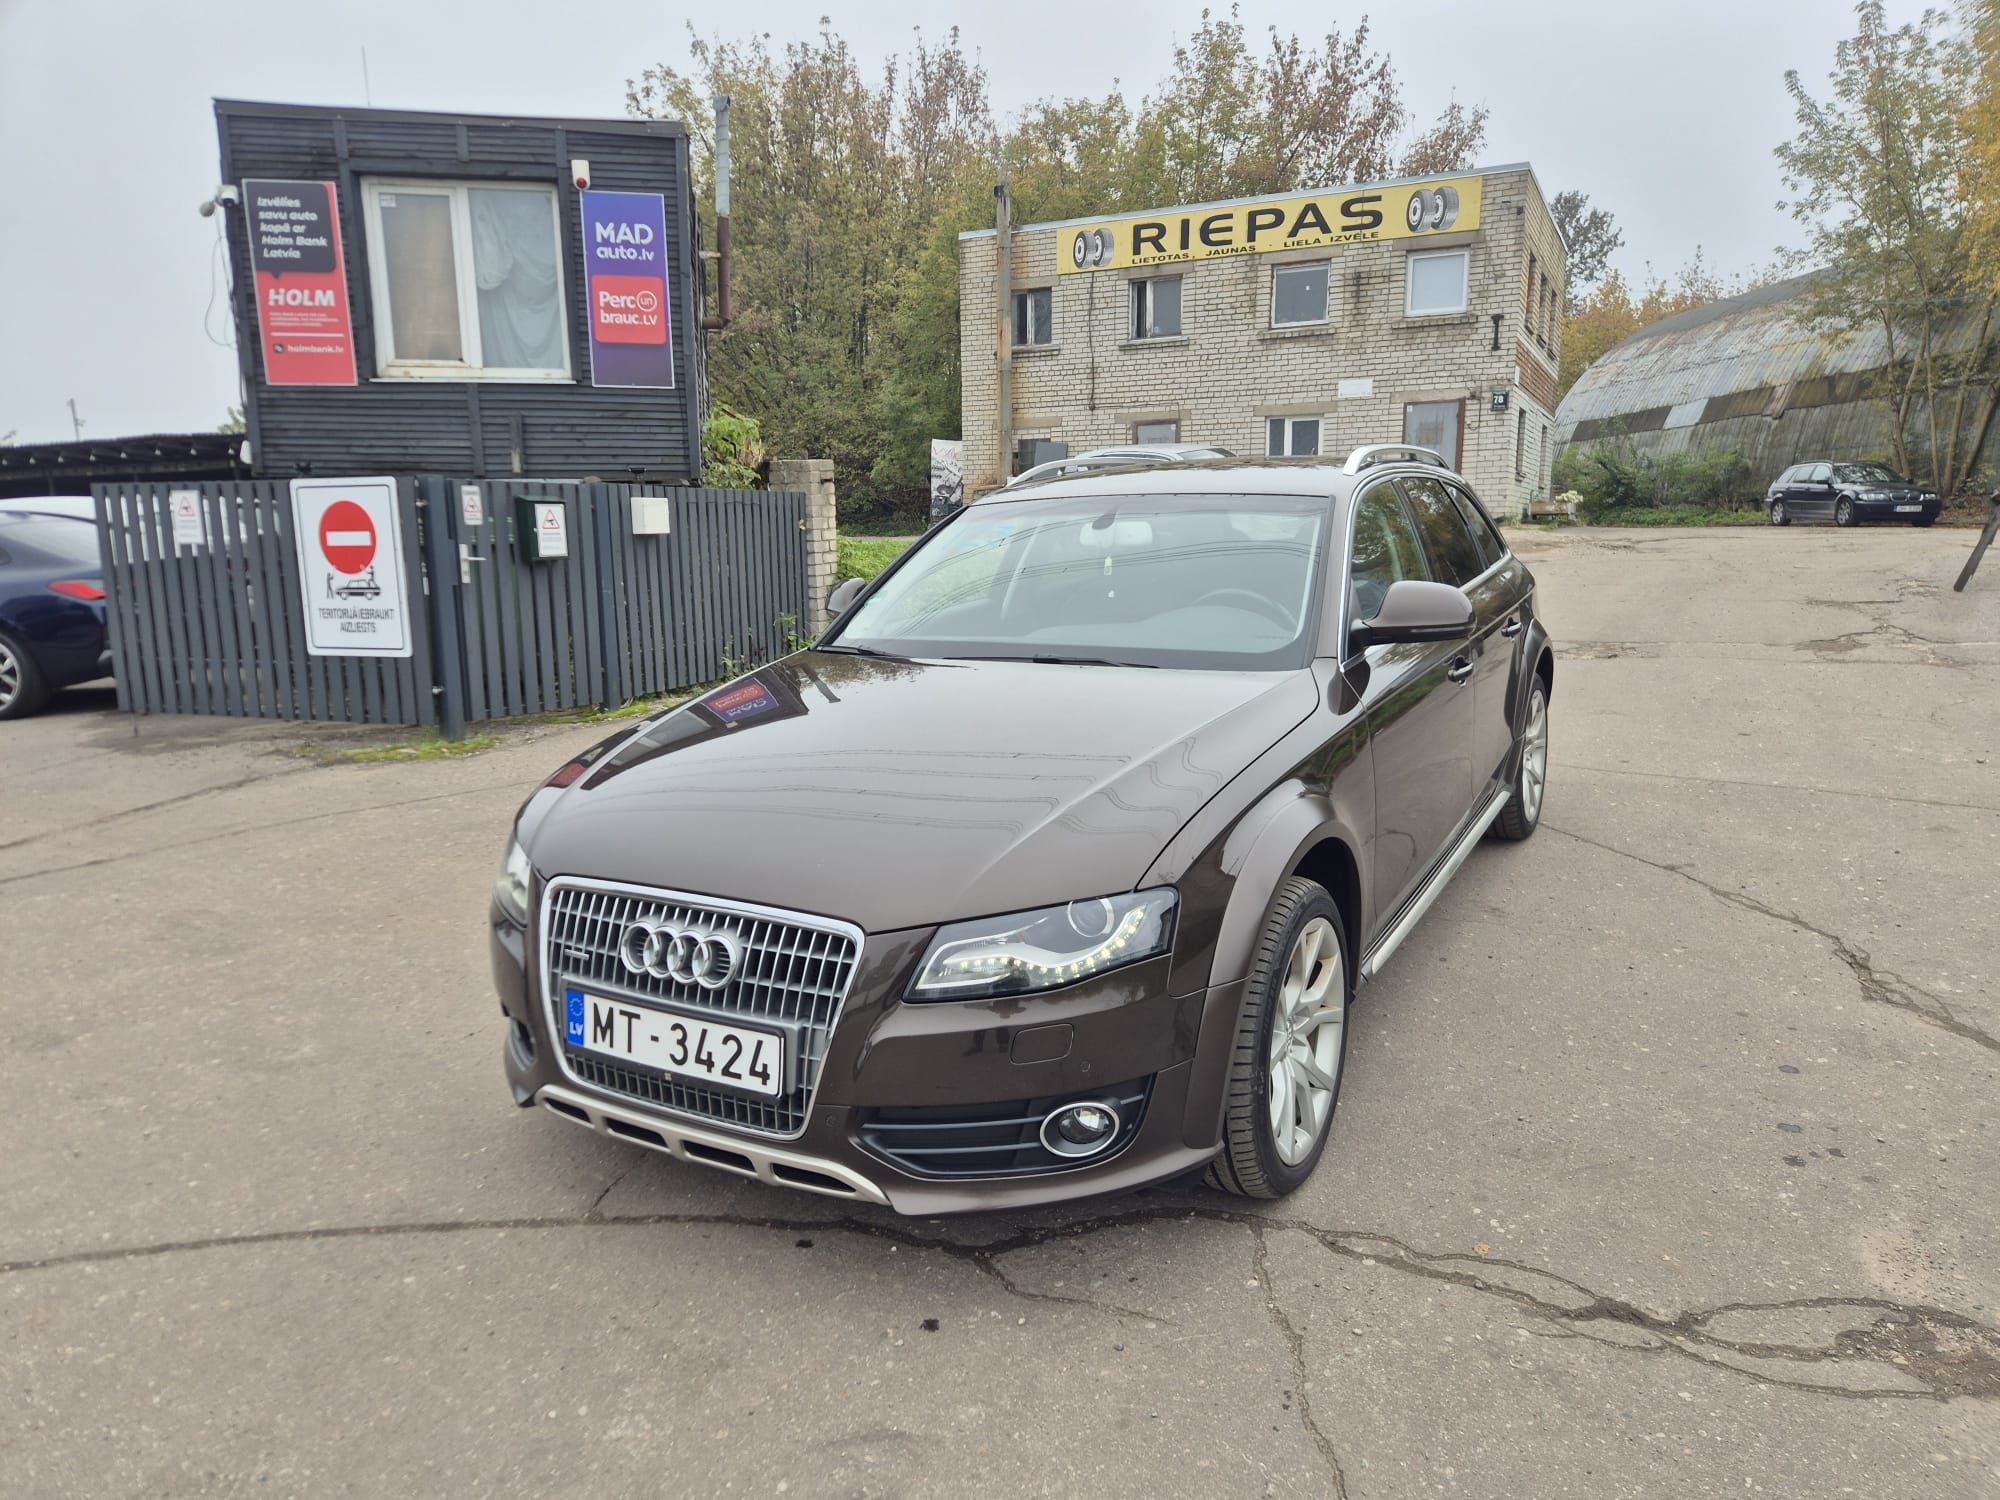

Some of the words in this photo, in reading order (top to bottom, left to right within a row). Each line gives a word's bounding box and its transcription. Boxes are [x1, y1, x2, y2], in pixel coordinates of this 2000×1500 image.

[258, 211, 287, 220] savu
[289, 211, 318, 221] auto
[260, 222, 291, 234] kopā
[292, 224, 306, 233] ar
[595, 221, 654, 245] MAD
[1131, 195, 1383, 256] RIEPAS
[262, 235, 294, 246] Holm
[295, 236, 328, 247] Bank
[1205, 245, 1257, 257] JAUNAS
[1283, 238, 1321, 248] LIELA
[263, 247, 302, 259] Latvia
[596, 245, 655, 261] auto.lv
[268, 287, 336, 307] HOLM
[599, 290, 637, 309] Perc
[640, 296, 654, 306] un
[1493, 394, 1504, 404] 78
[569, 1021, 583, 1036] LV
